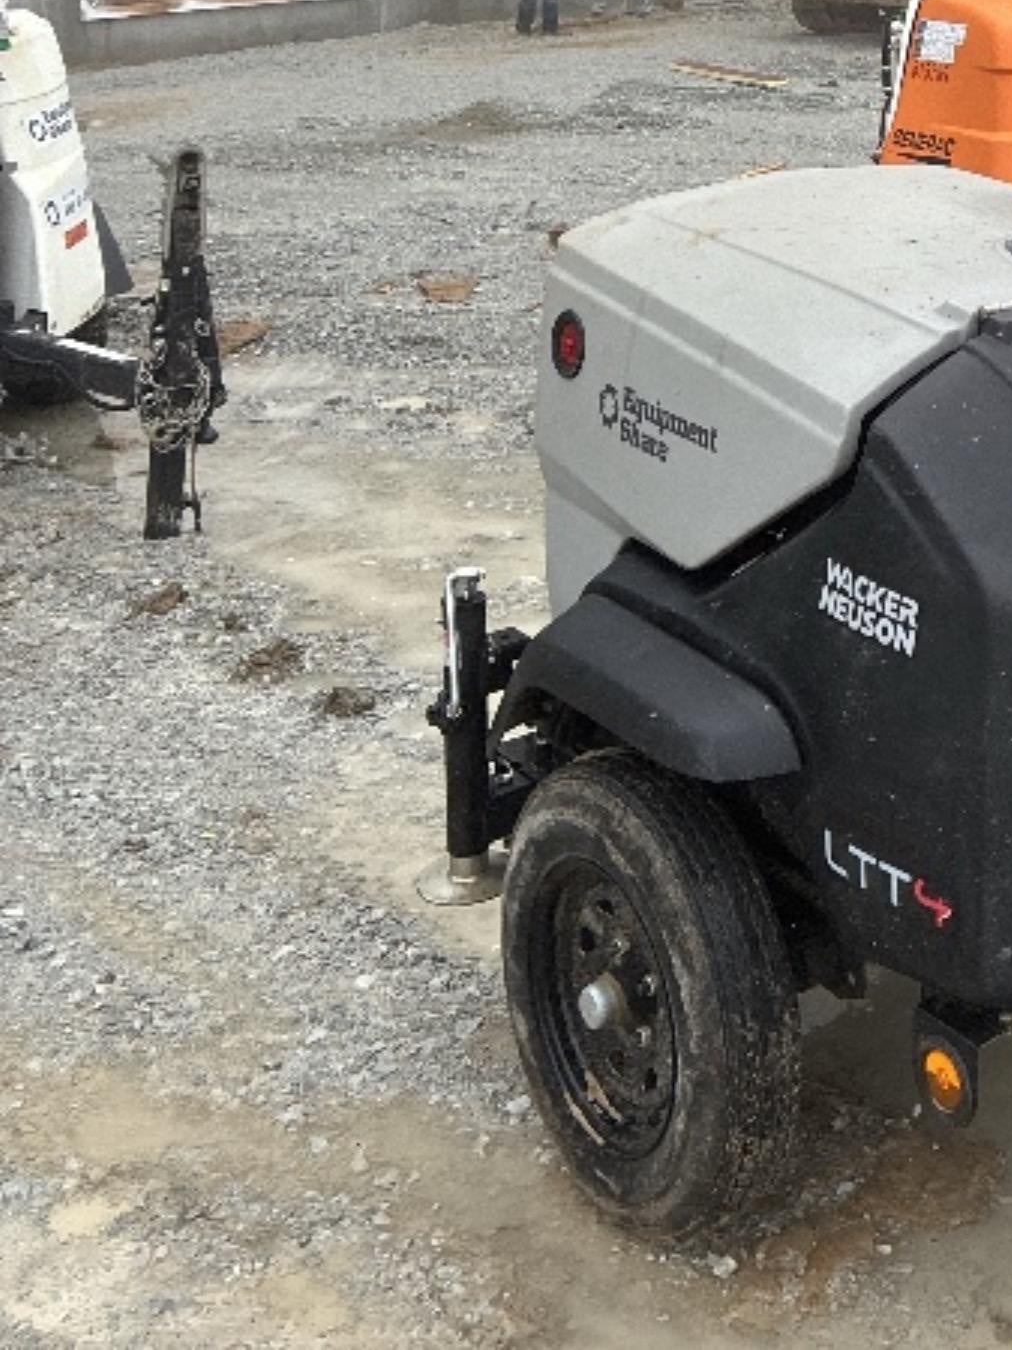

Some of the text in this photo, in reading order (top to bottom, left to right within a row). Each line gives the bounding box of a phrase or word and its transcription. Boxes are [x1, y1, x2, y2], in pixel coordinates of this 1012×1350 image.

[622, 385, 719, 455] Equipment
[818, 583, 917, 659] NEUSON
[826, 556, 920, 630] WACKER
